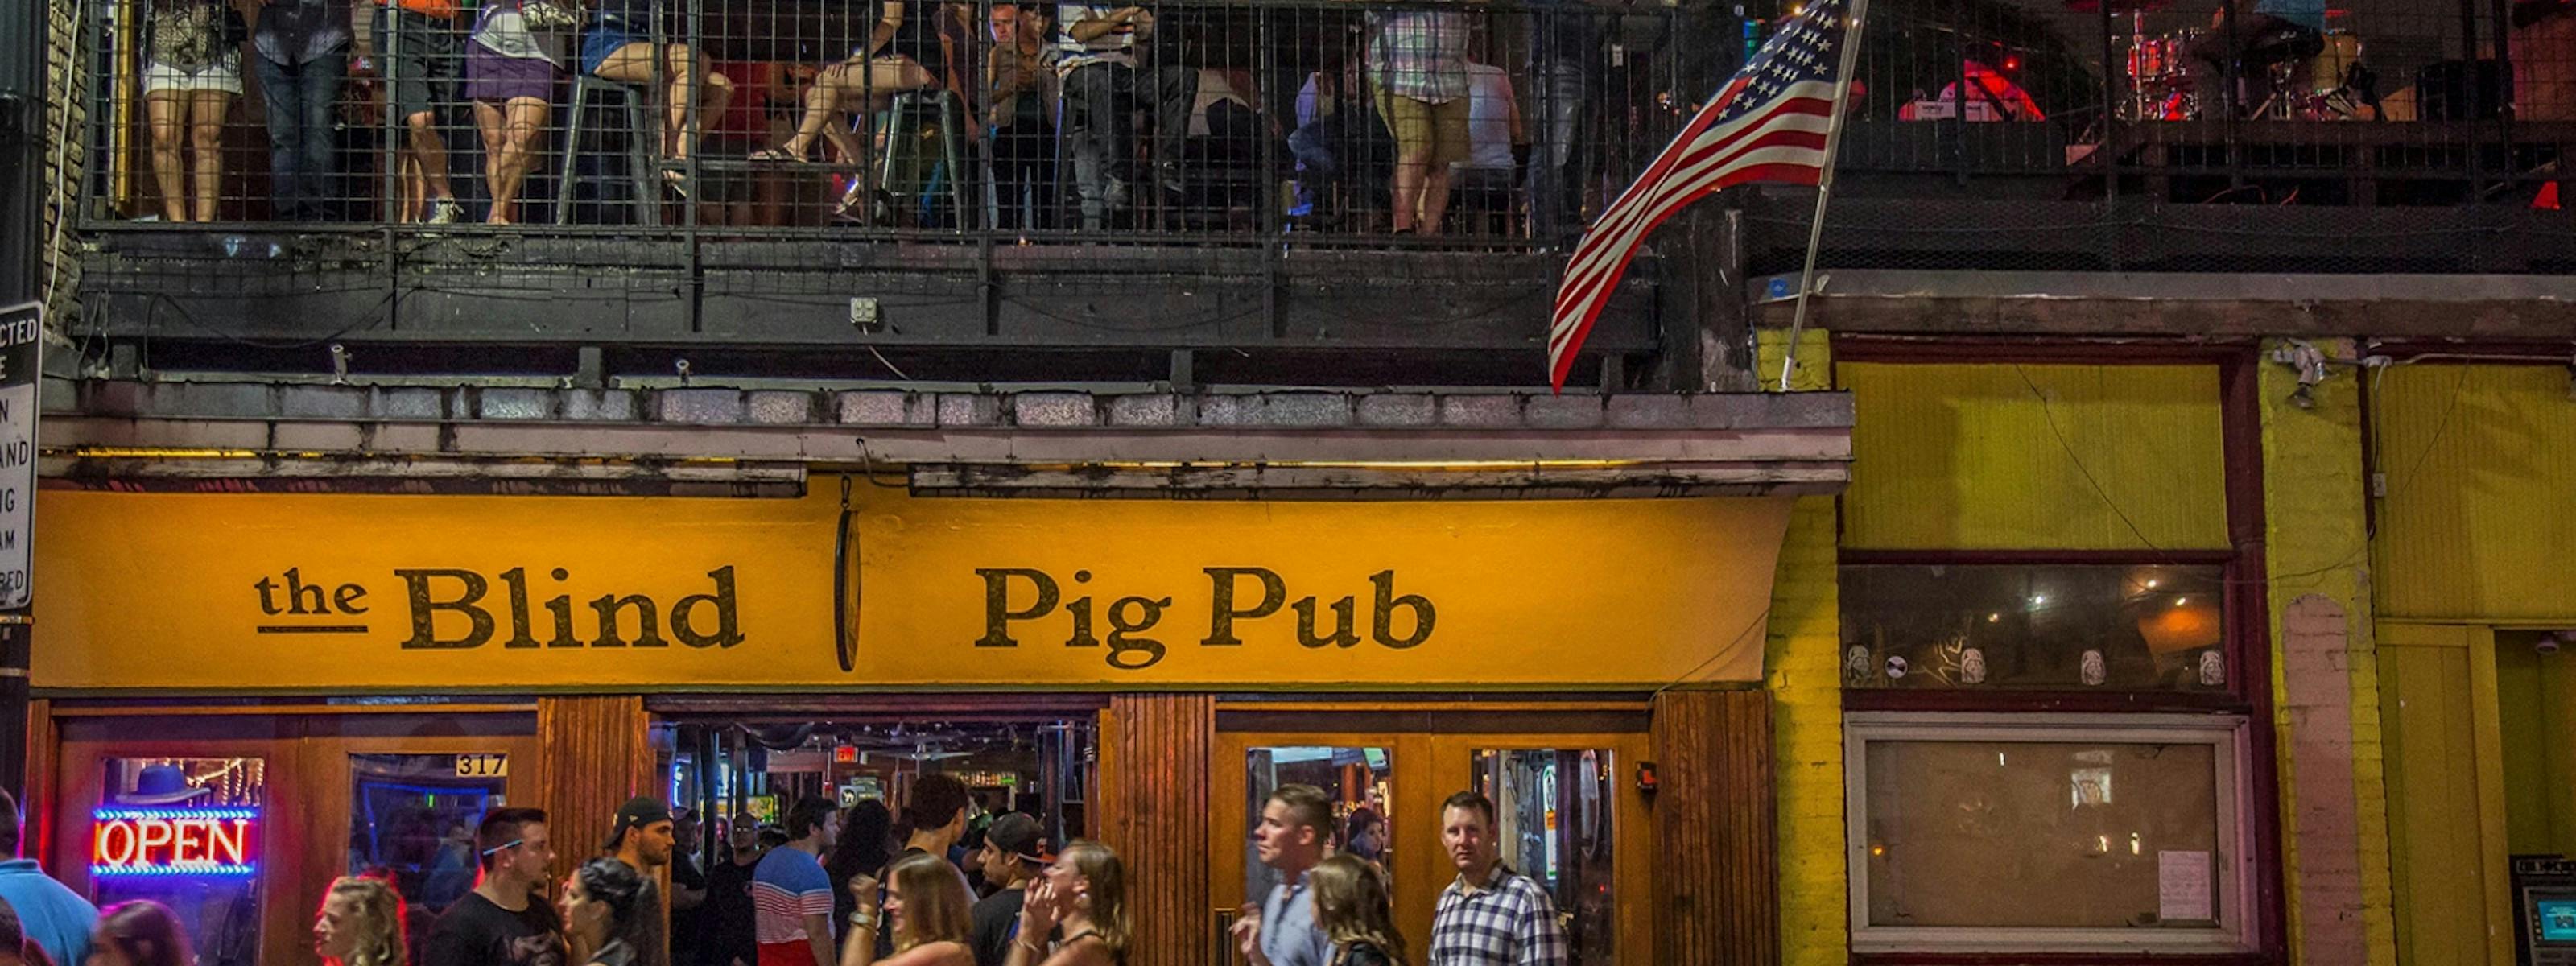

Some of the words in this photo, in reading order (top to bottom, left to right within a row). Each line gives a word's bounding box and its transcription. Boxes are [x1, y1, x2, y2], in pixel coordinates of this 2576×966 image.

[254, 567, 369, 616] the
[394, 565, 745, 650] Blind
[974, 568, 1172, 670] Pig
[1200, 567, 1436, 650] Pub
[459, 754, 506, 774] 317
[100, 818, 249, 867] OPEN
